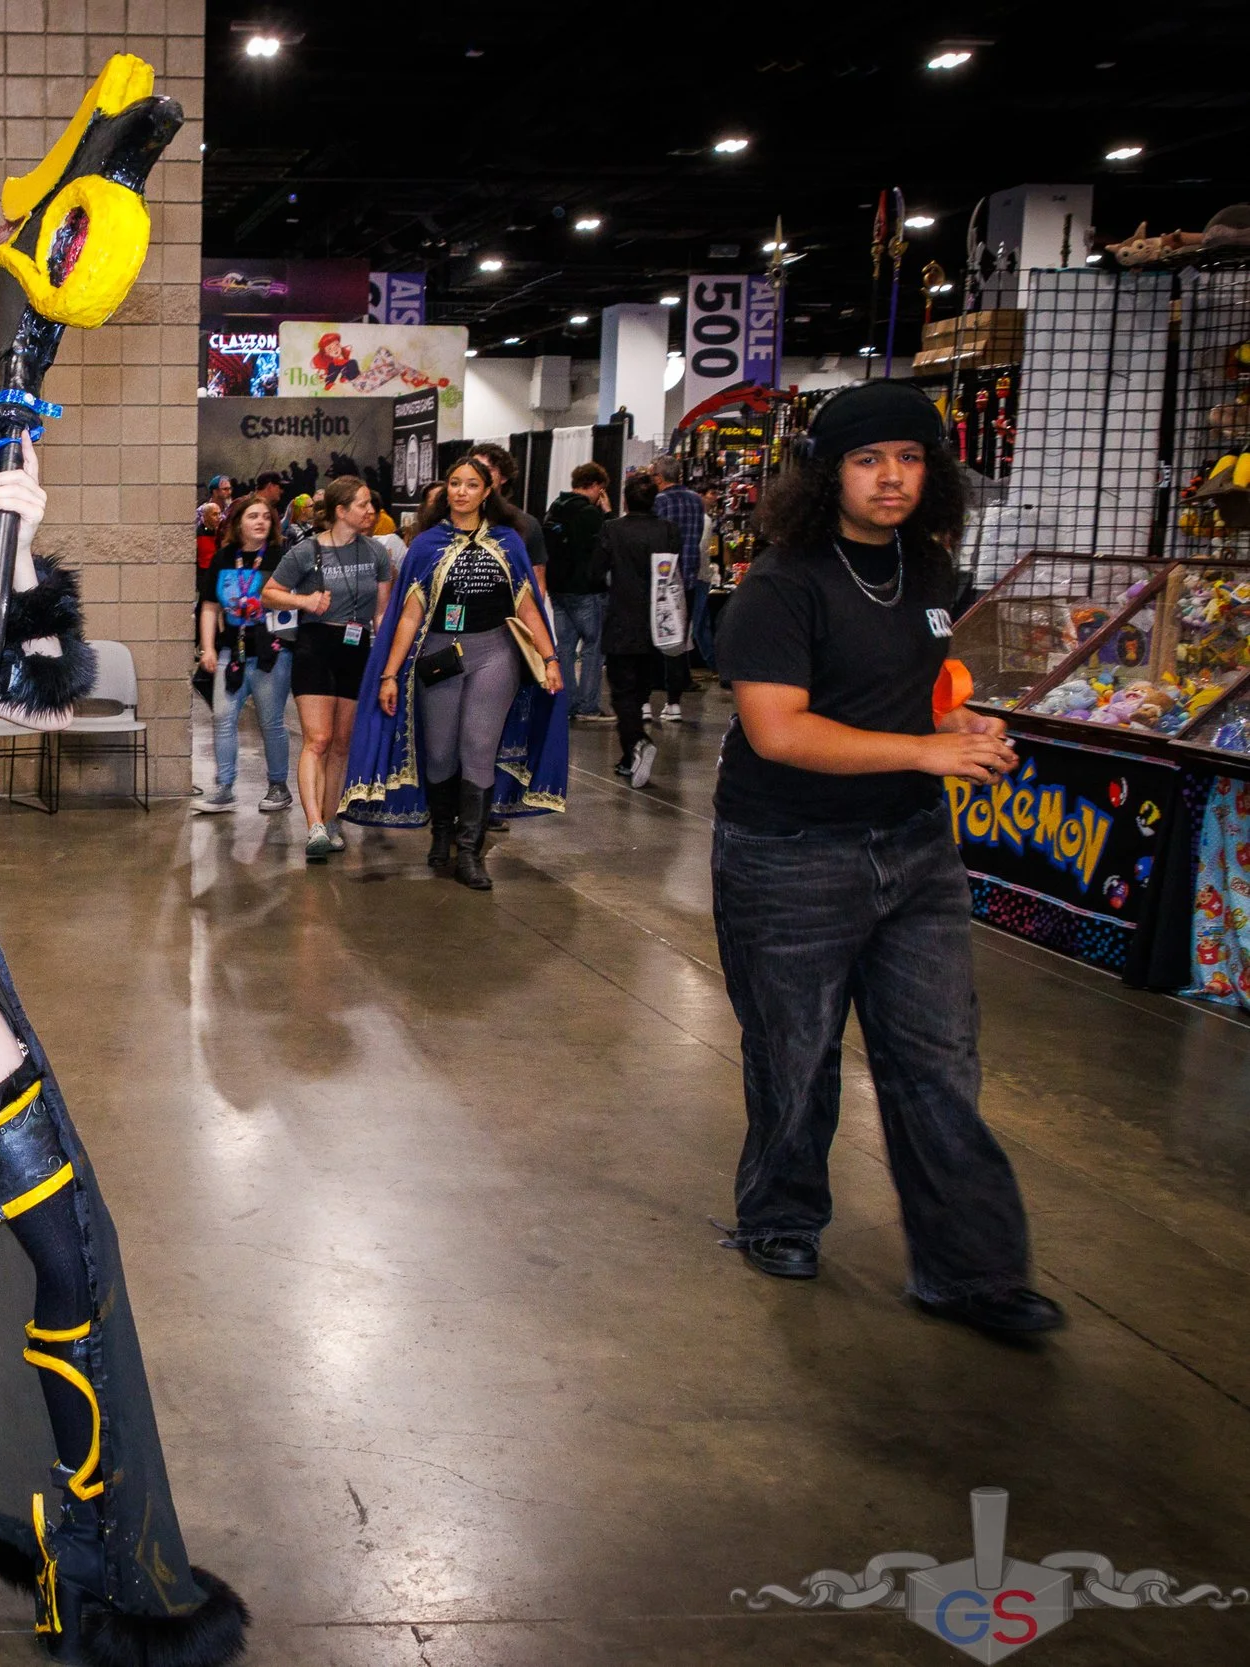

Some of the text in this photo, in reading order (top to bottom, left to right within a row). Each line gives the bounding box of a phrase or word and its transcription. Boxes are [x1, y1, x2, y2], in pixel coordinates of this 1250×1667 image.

[390, 278, 421, 324] AIS
[748, 280, 775, 361] AISLE
[209, 333, 278, 350] CLAYTON
[691, 281, 742, 378] 500
[284, 366, 320, 387] The
